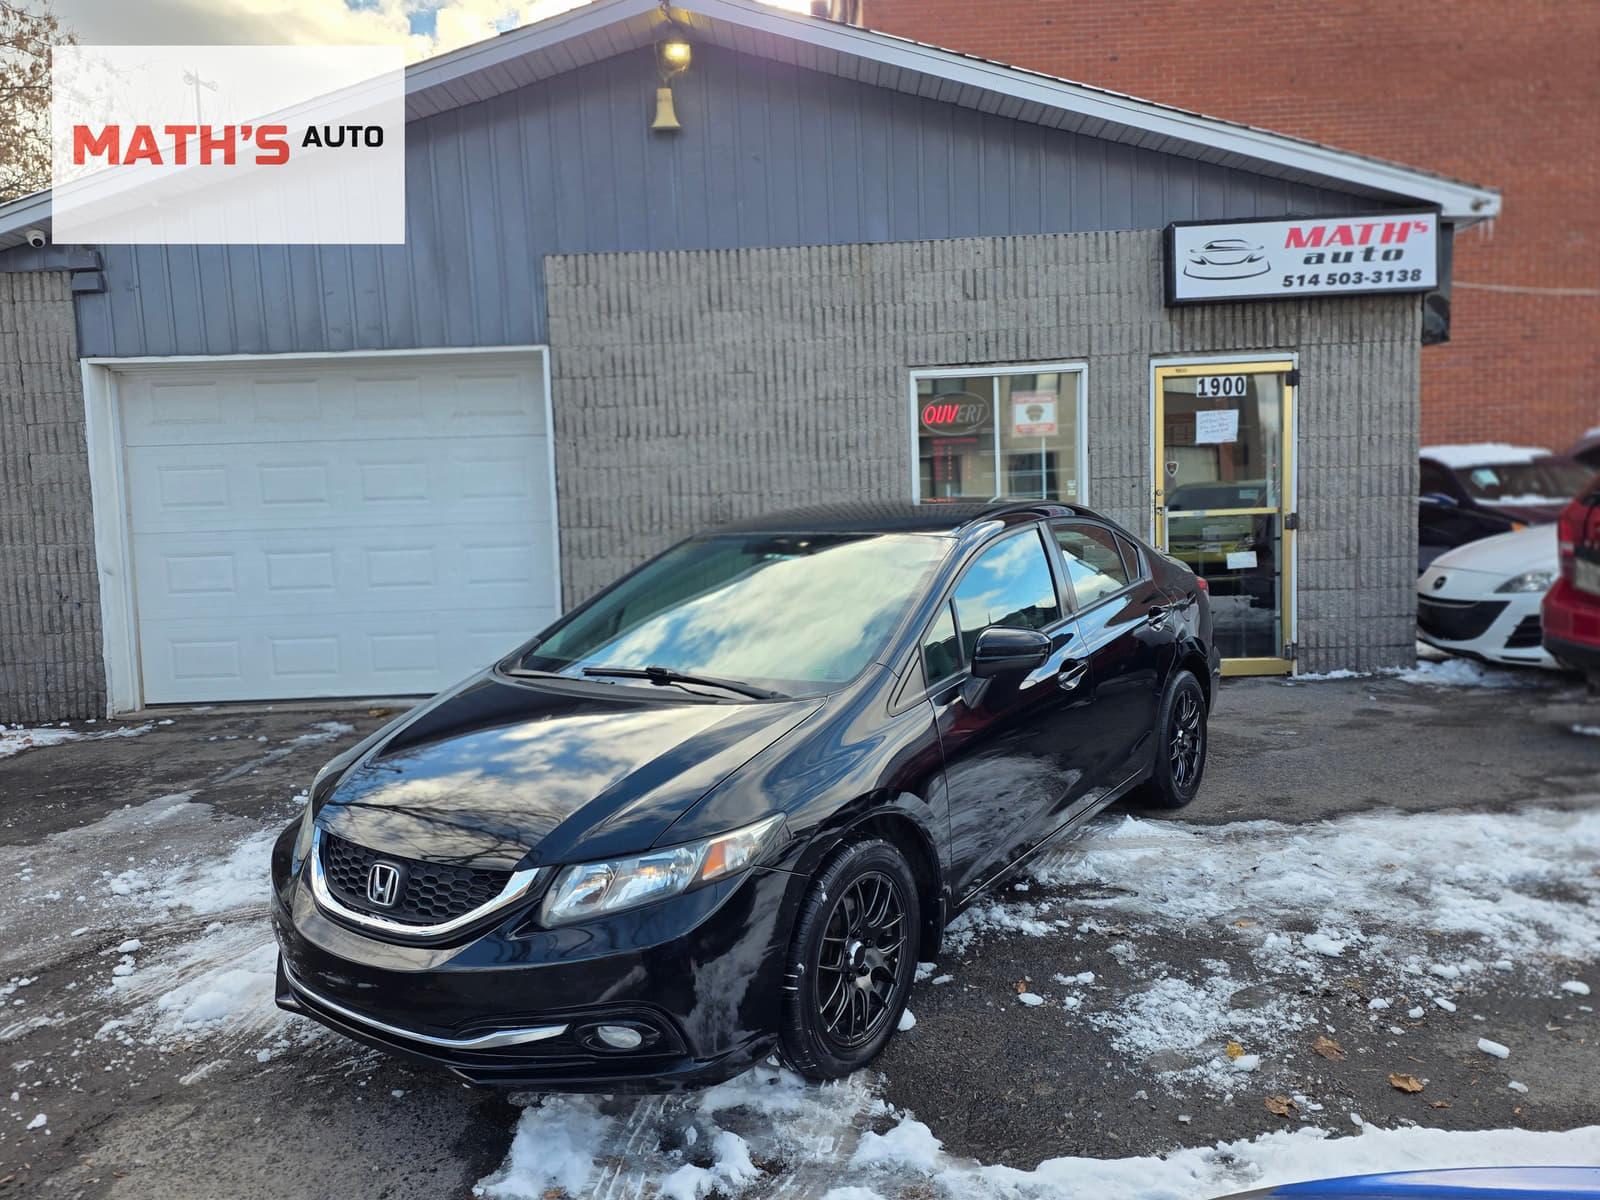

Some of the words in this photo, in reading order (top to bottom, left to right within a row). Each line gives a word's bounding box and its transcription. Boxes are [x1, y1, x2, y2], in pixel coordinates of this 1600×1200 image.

[1303, 246, 1404, 265] auto
[1282, 274, 1321, 287] 514
[1326, 269, 1422, 285] 503-3138
[1198, 377, 1245, 396] 1900
[924, 404, 984, 424] OUVERT
